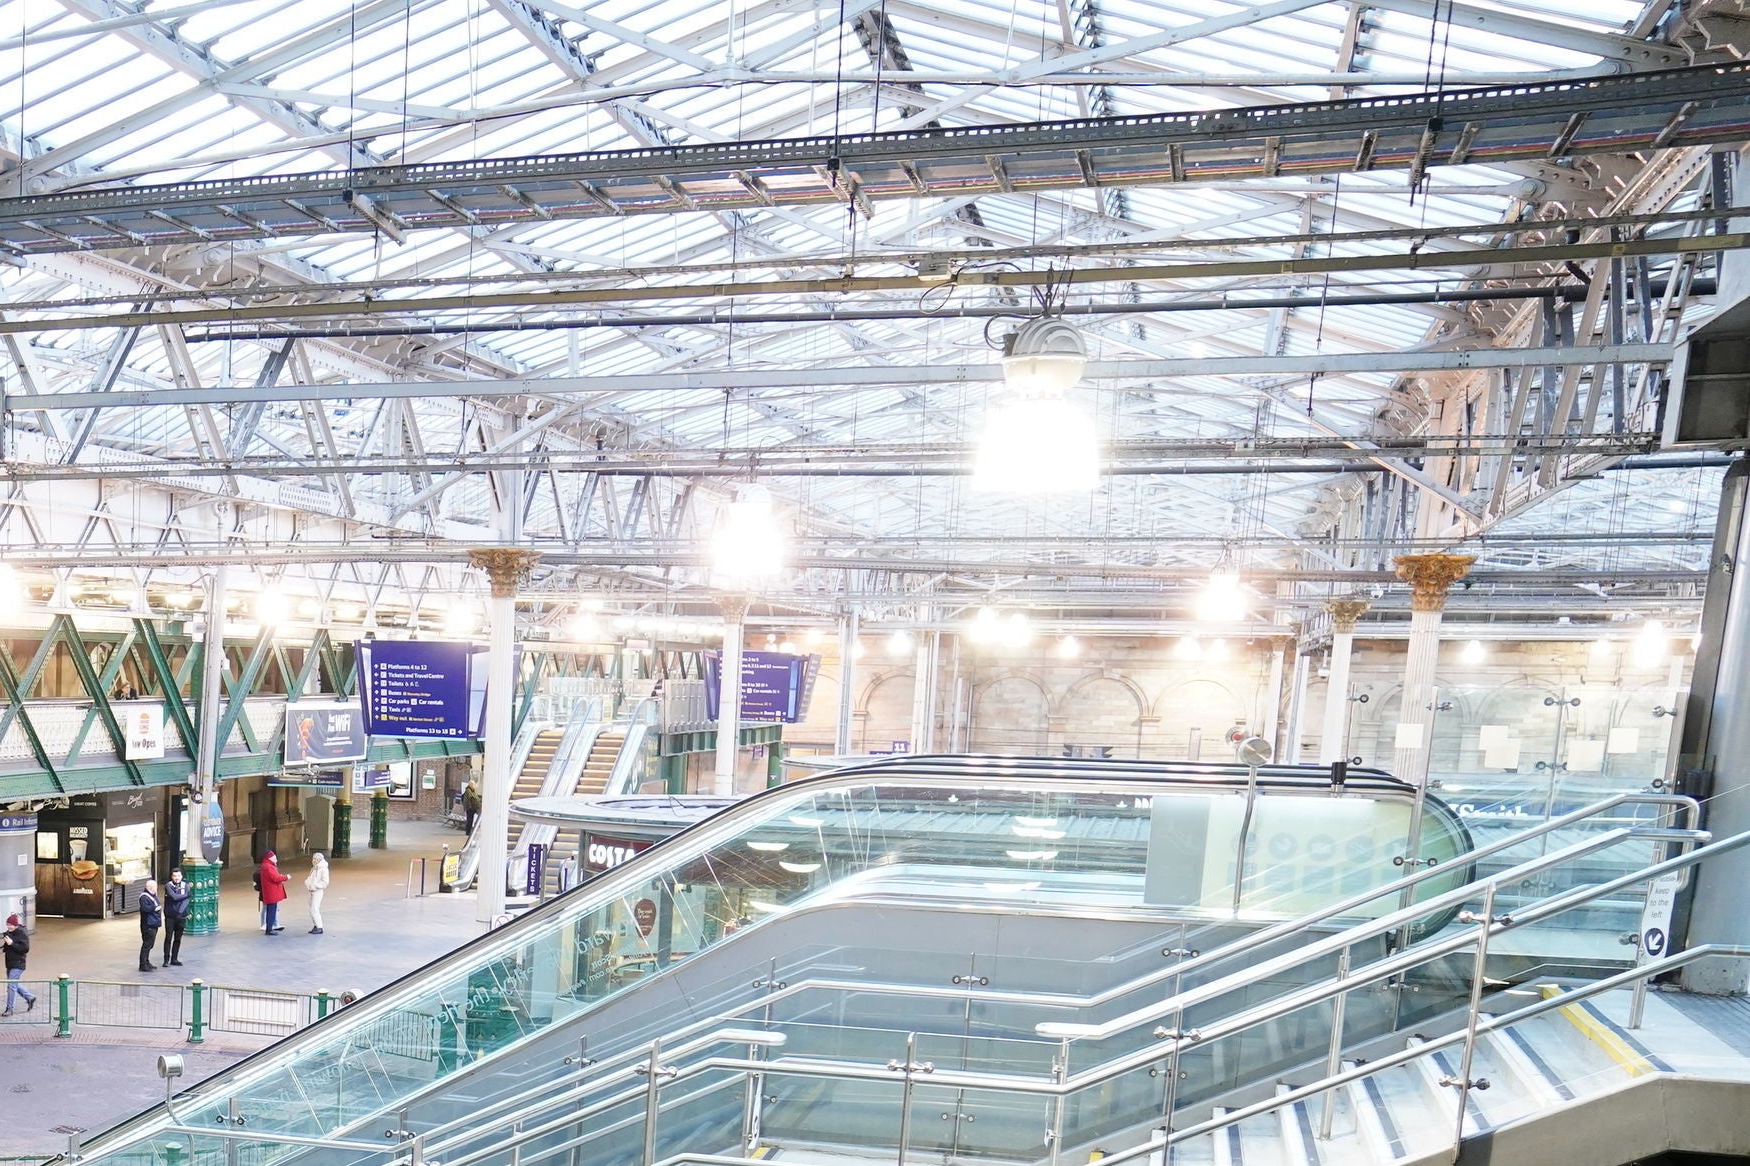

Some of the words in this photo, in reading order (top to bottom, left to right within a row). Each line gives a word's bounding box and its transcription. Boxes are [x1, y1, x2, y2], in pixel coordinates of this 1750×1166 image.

[894, 743, 906, 752] 11
[12, 818, 23, 826] Rail
[70, 826, 88, 834] MISSED
[203, 826, 221, 838] ADVICE
[588, 843, 636, 868] COSTA
[530, 846, 538, 892] TICKETS
[1650, 911, 1663, 919] left
